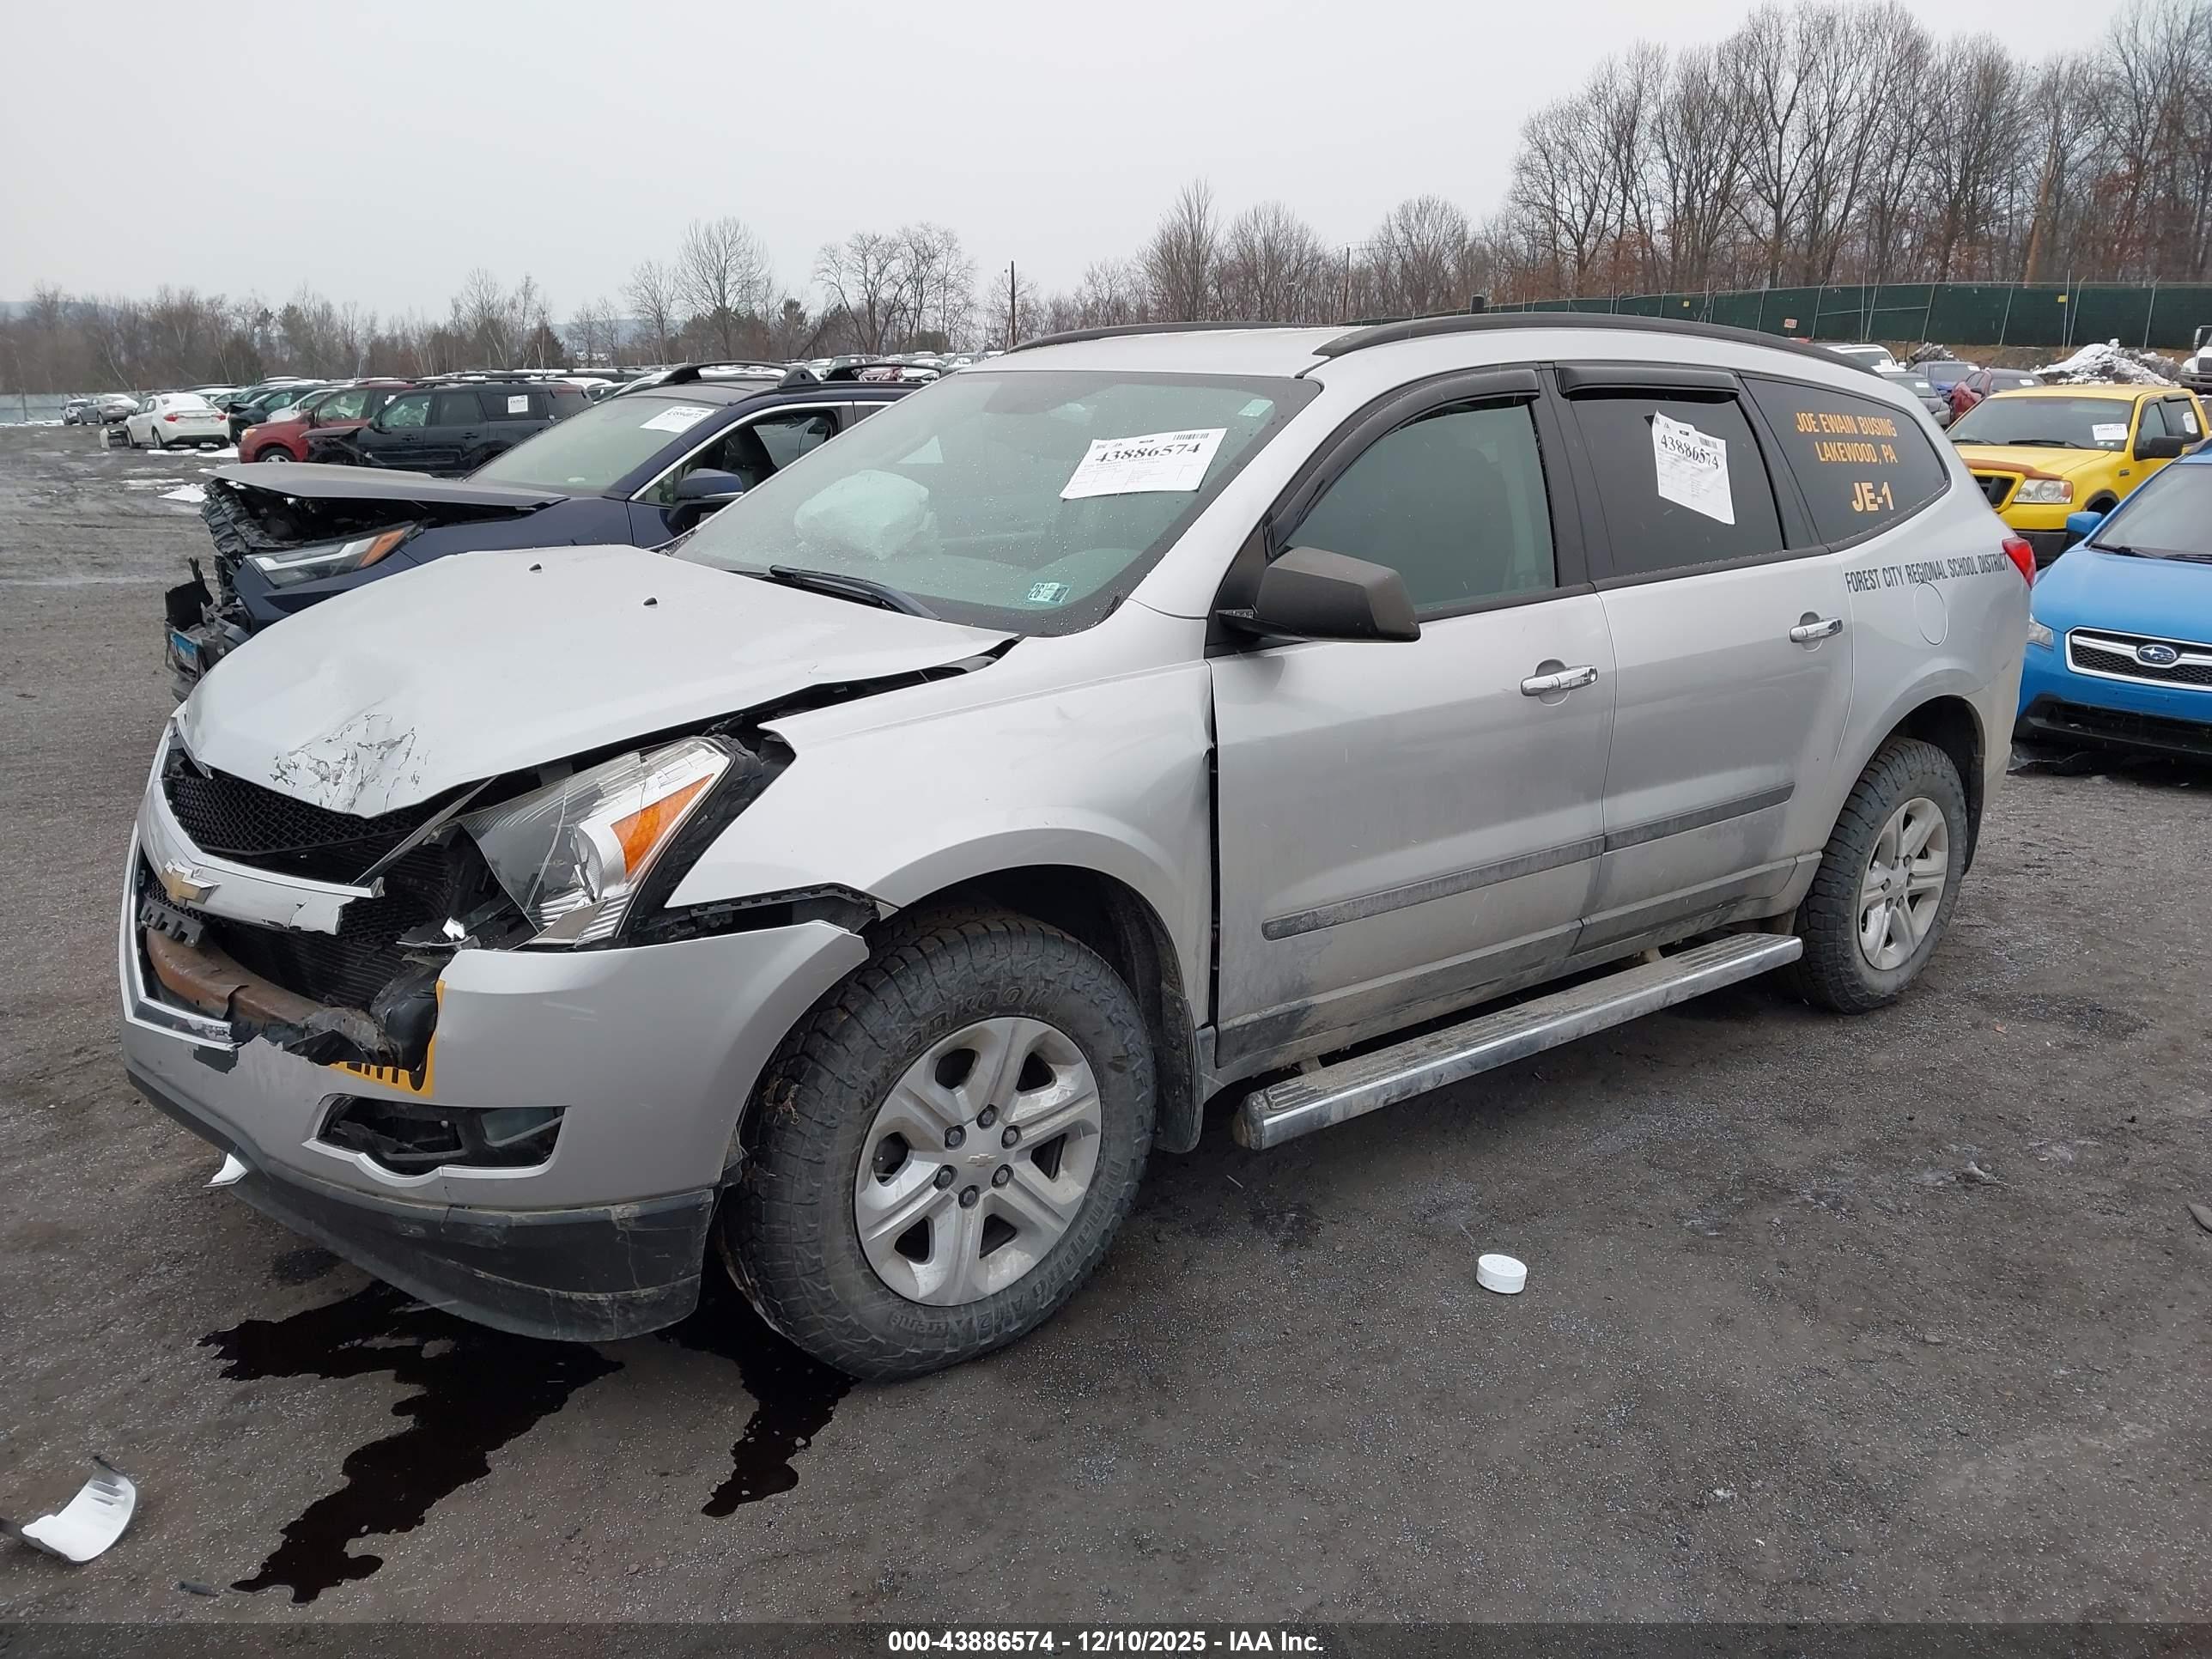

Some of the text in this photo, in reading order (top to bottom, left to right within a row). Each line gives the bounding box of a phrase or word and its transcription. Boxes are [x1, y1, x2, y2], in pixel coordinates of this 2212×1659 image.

[1796, 412, 1898, 437] JOE EWAIN BUSING
[1096, 441, 1201, 463] 43886574
[1660, 434, 1719, 470] 43886574
[1814, 441, 1898, 465] LAKEWOOD, PA
[1851, 481, 1895, 513] JE-1
[1844, 551, 2009, 593] FOREST CITY REGIONAL SCHOOL DISTRICT
